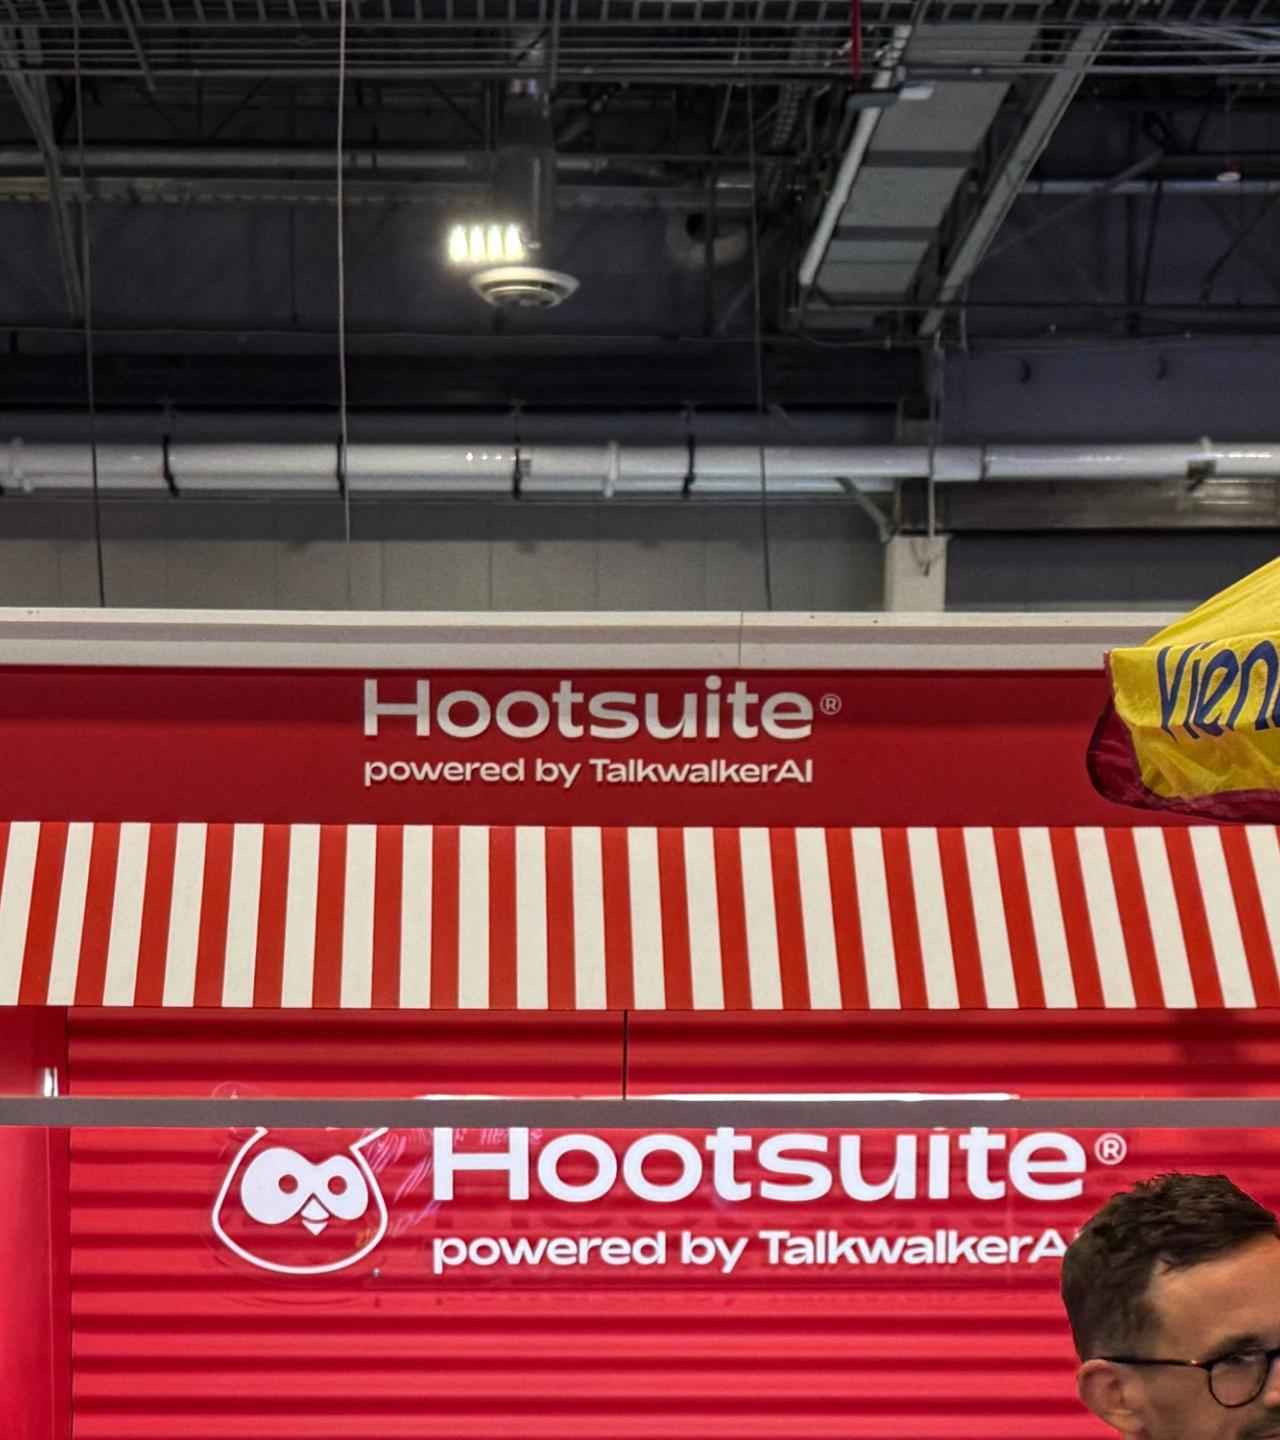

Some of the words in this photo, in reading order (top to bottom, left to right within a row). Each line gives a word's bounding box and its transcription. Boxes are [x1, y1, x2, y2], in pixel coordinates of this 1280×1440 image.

[364, 758, 525, 787] powered
[536, 758, 581, 788] by
[589, 758, 814, 784] TalkwalkerAI
[434, 1230, 665, 1272] powered
[680, 1230, 749, 1272] by
[759, 1230, 1068, 1266] TalkwalkerA
